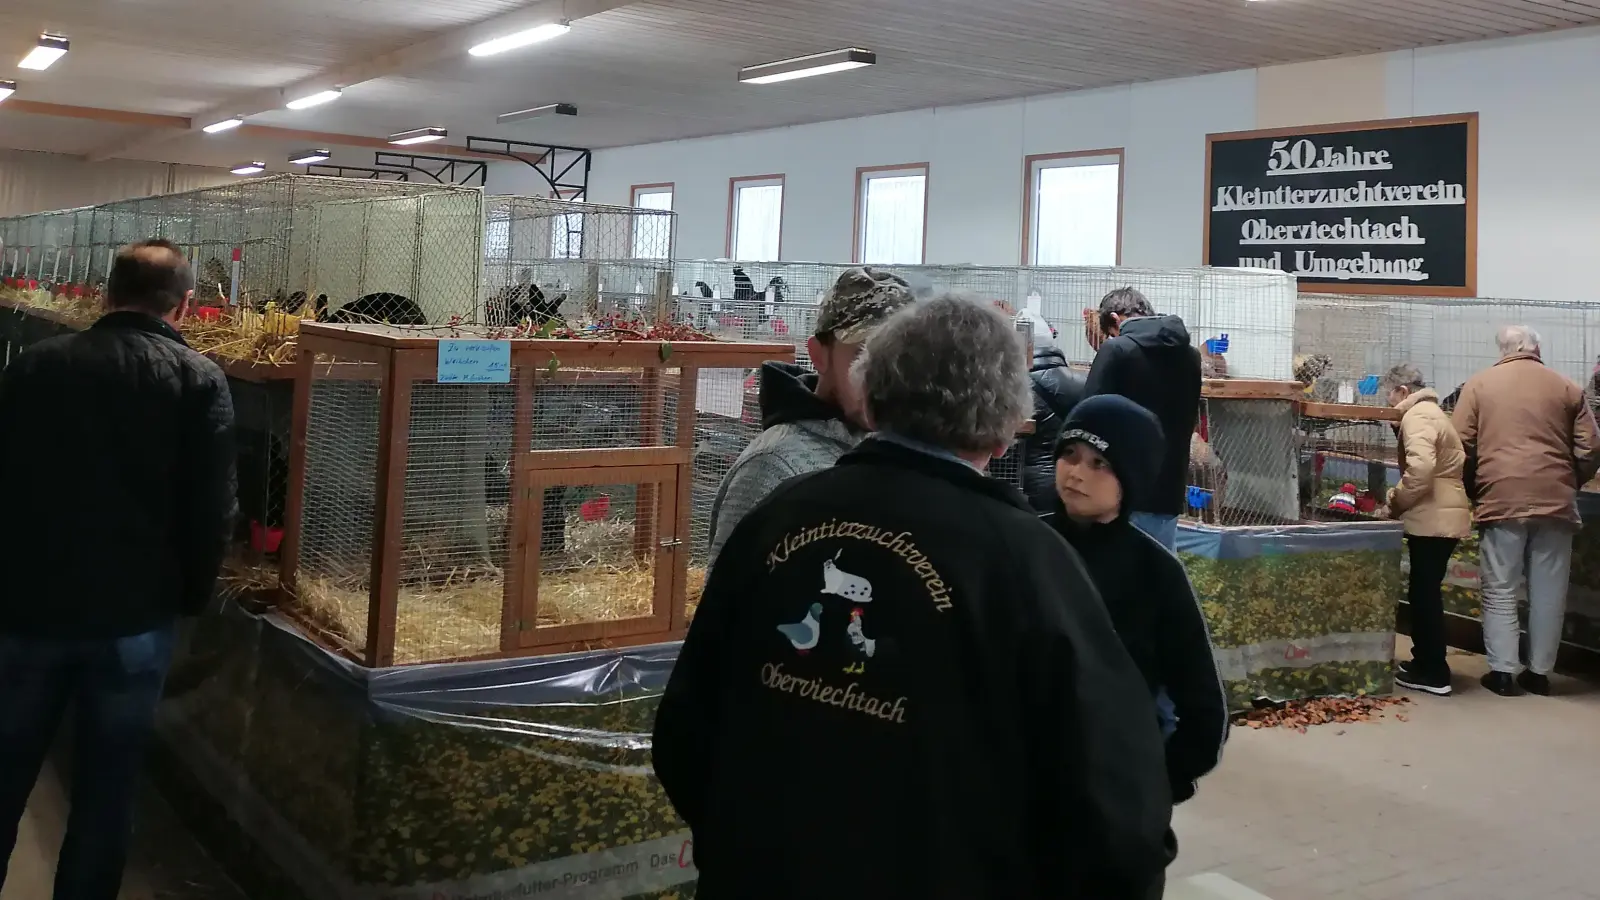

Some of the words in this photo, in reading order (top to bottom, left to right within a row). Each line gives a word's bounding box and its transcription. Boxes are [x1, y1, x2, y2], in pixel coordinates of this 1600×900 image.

[1268, 139, 1317, 171] 50
[1316, 146, 1390, 168] Jahre
[1215, 180, 1465, 208] Kleintierzuchtverein
[1241, 216, 1419, 240] Oberviechtach
[1239, 252, 1282, 270] und
[1296, 250, 1425, 280] Umgebung
[765, 517, 954, 613] Kleintierzuchtverein
[761, 662, 908, 723] Oberviechtach
[650, 850, 677, 868] Das
